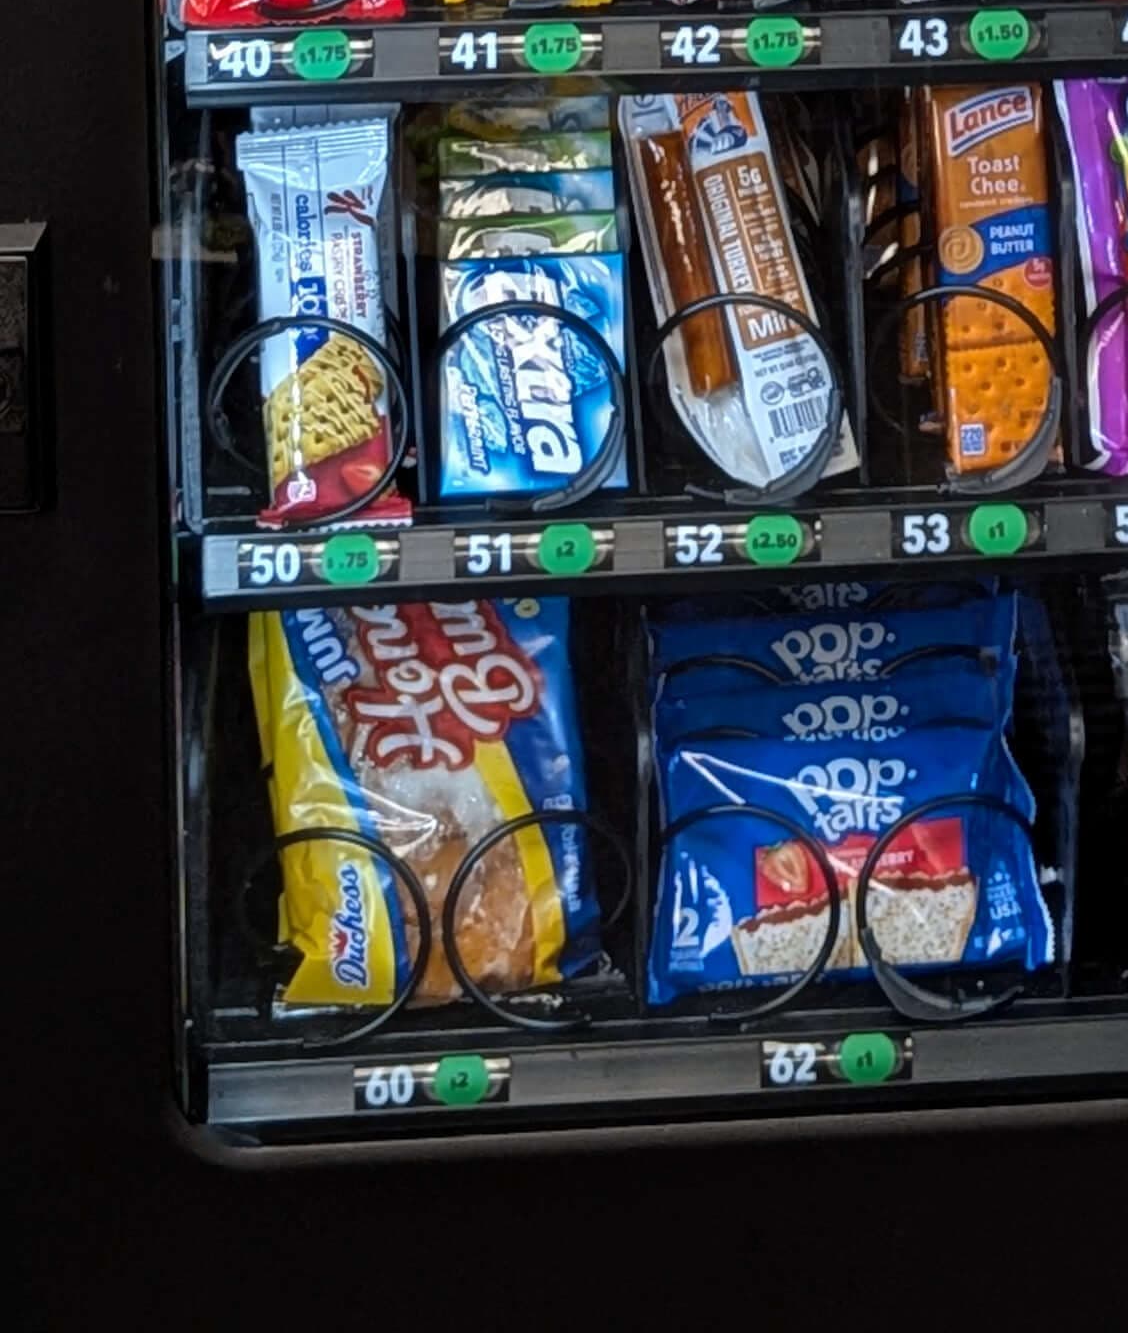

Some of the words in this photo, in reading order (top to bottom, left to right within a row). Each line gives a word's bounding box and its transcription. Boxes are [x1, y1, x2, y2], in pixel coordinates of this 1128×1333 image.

[530, 37, 578, 56] $1.75
[671, 25, 721, 64] 42
[752, 30, 798, 49] $1.75
[899, 19, 948, 55] 43
[976, 23, 1024, 41] $1.50
[219, 40, 271, 77] 40
[299, 43, 346, 63] $1.75
[451, 32, 498, 69] 41
[950, 93, 1027, 140] Lance
[967, 154, 1020, 175] Toast
[970, 177, 1020, 196] Chee
[704, 173, 739, 242] ORIGINAL
[295, 193, 318, 273] calories
[989, 222, 1035, 240] PEANUT
[990, 239, 1035, 256] BUTTER
[351, 232, 367, 319] STRAWBERRY
[461, 270, 583, 474] Extra
[674, 528, 724, 564] 52
[752, 532, 798, 549] $2.50
[902, 514, 950, 554] 53
[988, 520, 1006, 539] $1
[250, 543, 301, 583] 50
[466, 534, 512, 574] 51
[556, 540, 576, 559] $2
[336, 863, 368, 988] Duchess
[677, 908, 703, 947] 2
[769, 1044, 819, 1082] 62
[856, 1048, 875, 1068] $1
[364, 1070, 416, 1106] 60
[449, 1071, 470, 1092] $2
